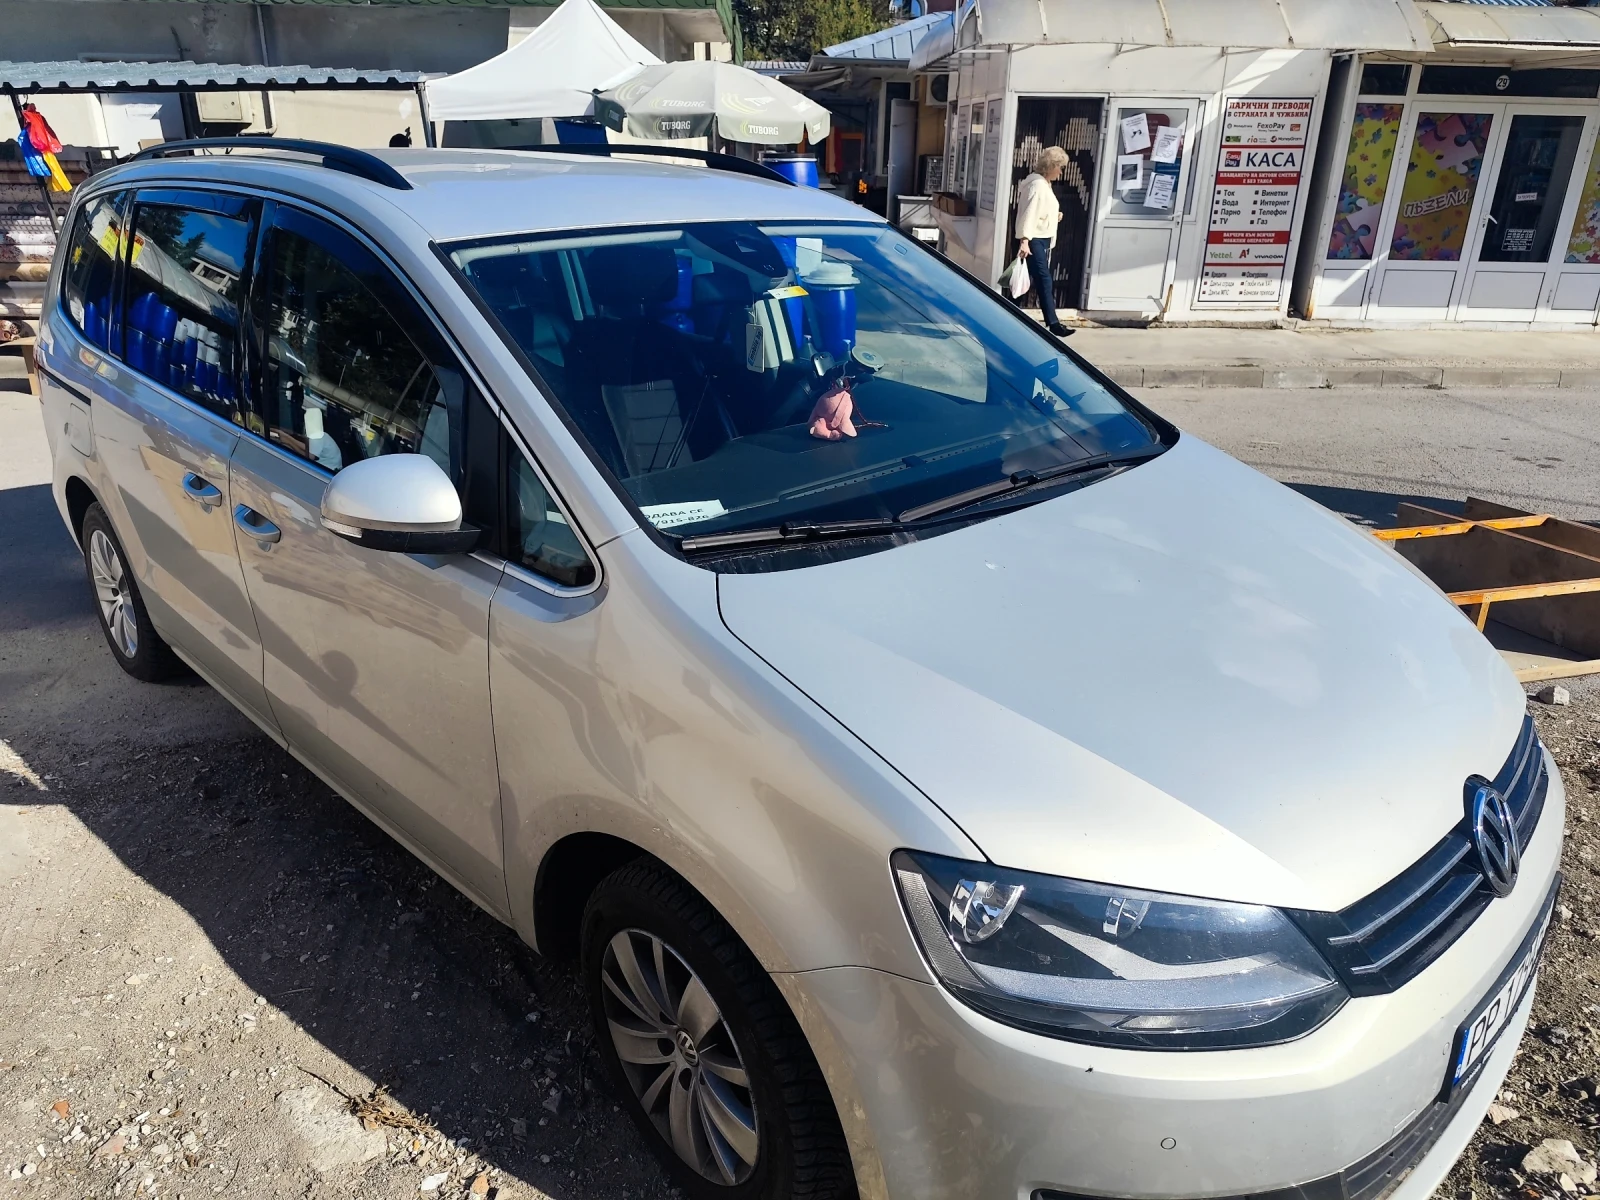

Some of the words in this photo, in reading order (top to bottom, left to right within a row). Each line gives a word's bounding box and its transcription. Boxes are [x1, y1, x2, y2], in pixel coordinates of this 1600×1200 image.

[1497, 77, 1508, 88] 29
[661, 100, 706, 108] TUBORG
[1230, 102, 1269, 110] ПАРИЧНИ
[1272, 102, 1310, 110] ПРЕВОДИ
[661, 120, 691, 131] TUBORG
[748, 124, 779, 135] TUBORG
[1257, 122, 1286, 130] FexoPay
[1226, 152, 1240, 160] Easy
[1246, 152, 1296, 167] КАСА
[1260, 199, 1290, 207] Интернет
[1404, 189, 1470, 218] ПЪЗЕЛИ
[1220, 208, 1241, 216] Парно
[1259, 208, 1288, 217] Телефон
[1210, 251, 1233, 259] Yettel
[1239, 248, 1250, 259] A1
